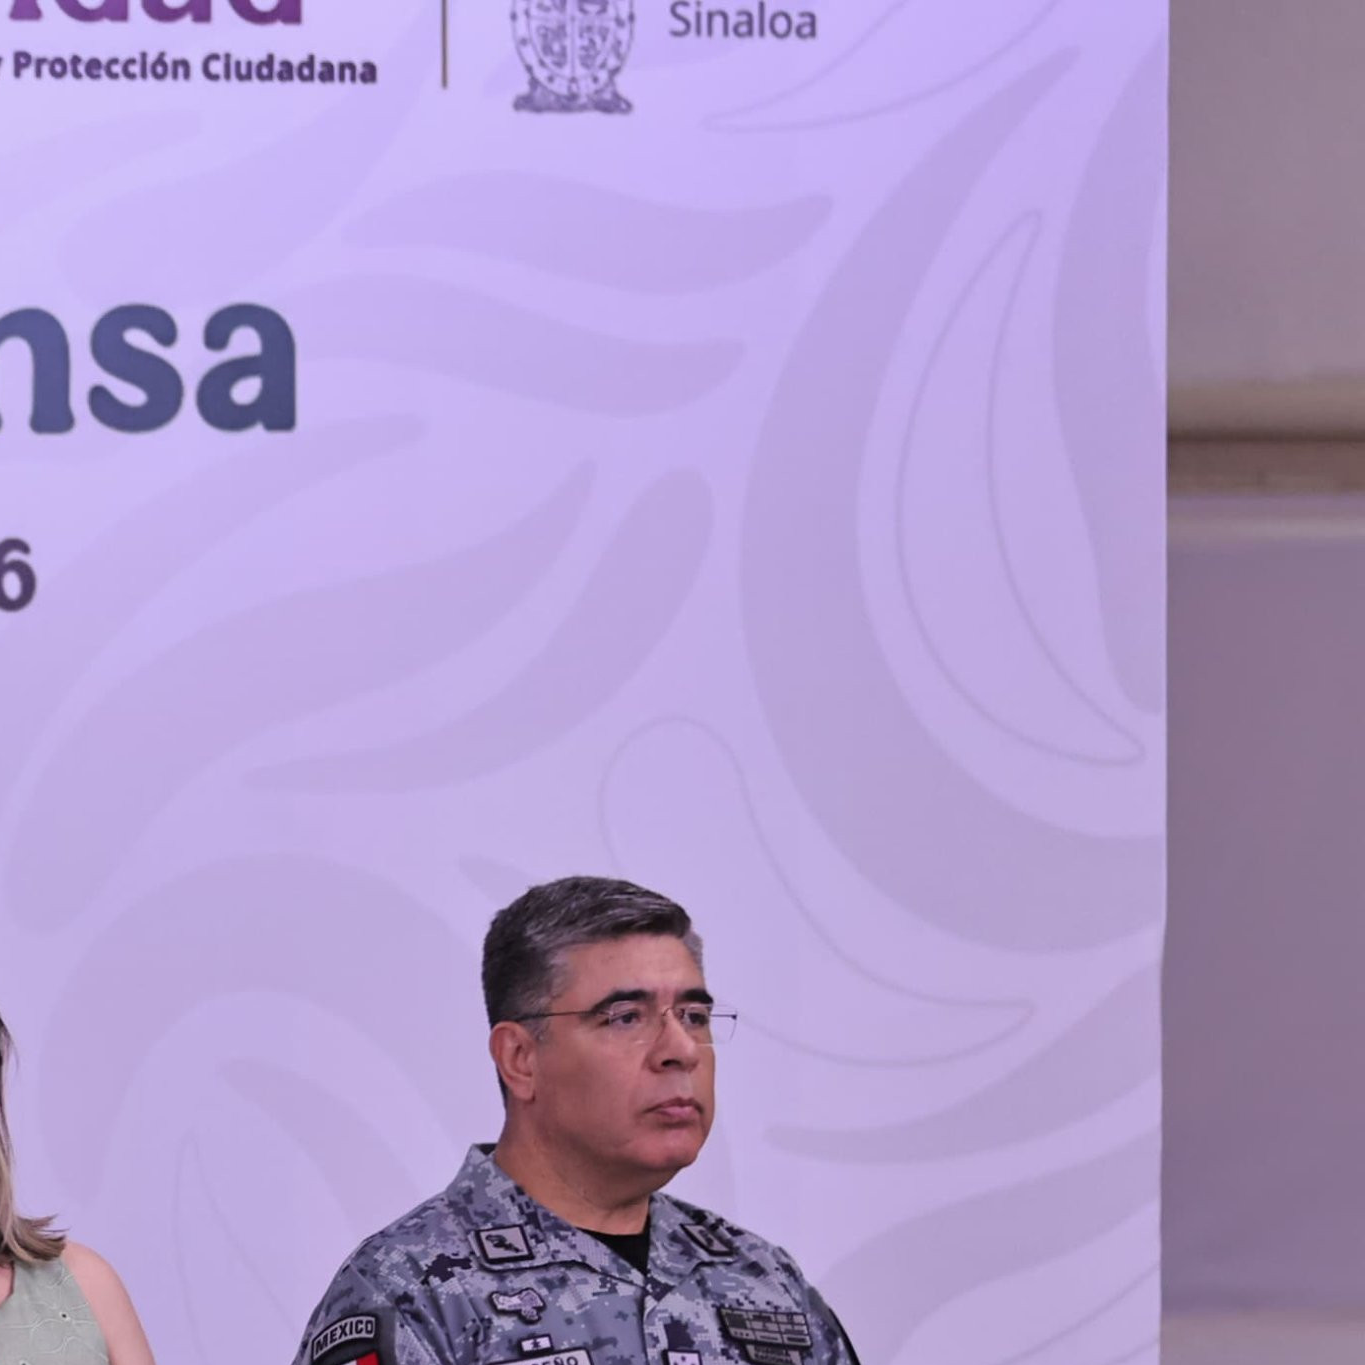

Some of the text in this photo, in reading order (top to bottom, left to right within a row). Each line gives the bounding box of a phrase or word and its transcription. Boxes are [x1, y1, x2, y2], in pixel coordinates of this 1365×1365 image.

[669, 0, 817, 39] Sinaloa
[13, 50, 191, 81] Protección
[201, 52, 378, 84] Ciudadana
[315, 1318, 375, 1355] MEXICO
